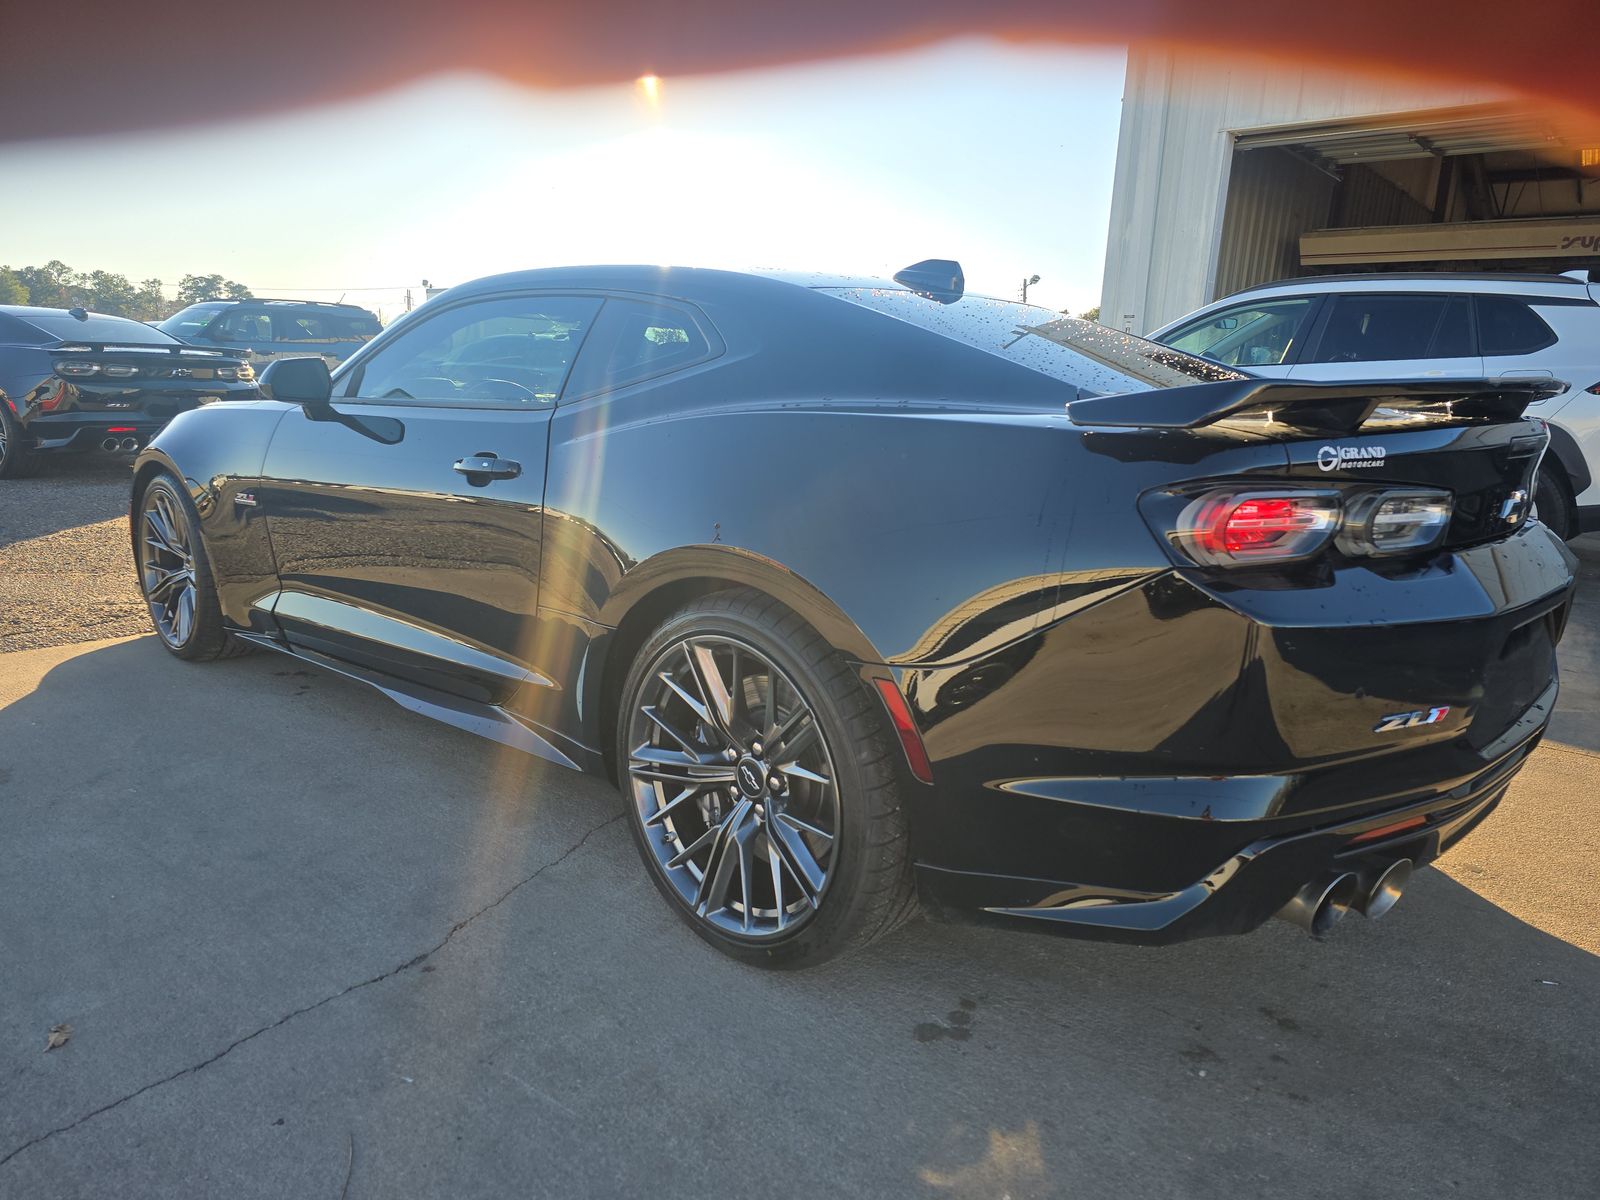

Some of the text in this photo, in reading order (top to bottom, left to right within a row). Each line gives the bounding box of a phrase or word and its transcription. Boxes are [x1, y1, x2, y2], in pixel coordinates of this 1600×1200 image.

[1340, 446, 1387, 460] GRAND
[1340, 460, 1385, 469] MOTORCARS
[1374, 706, 1450, 733] ZL1
